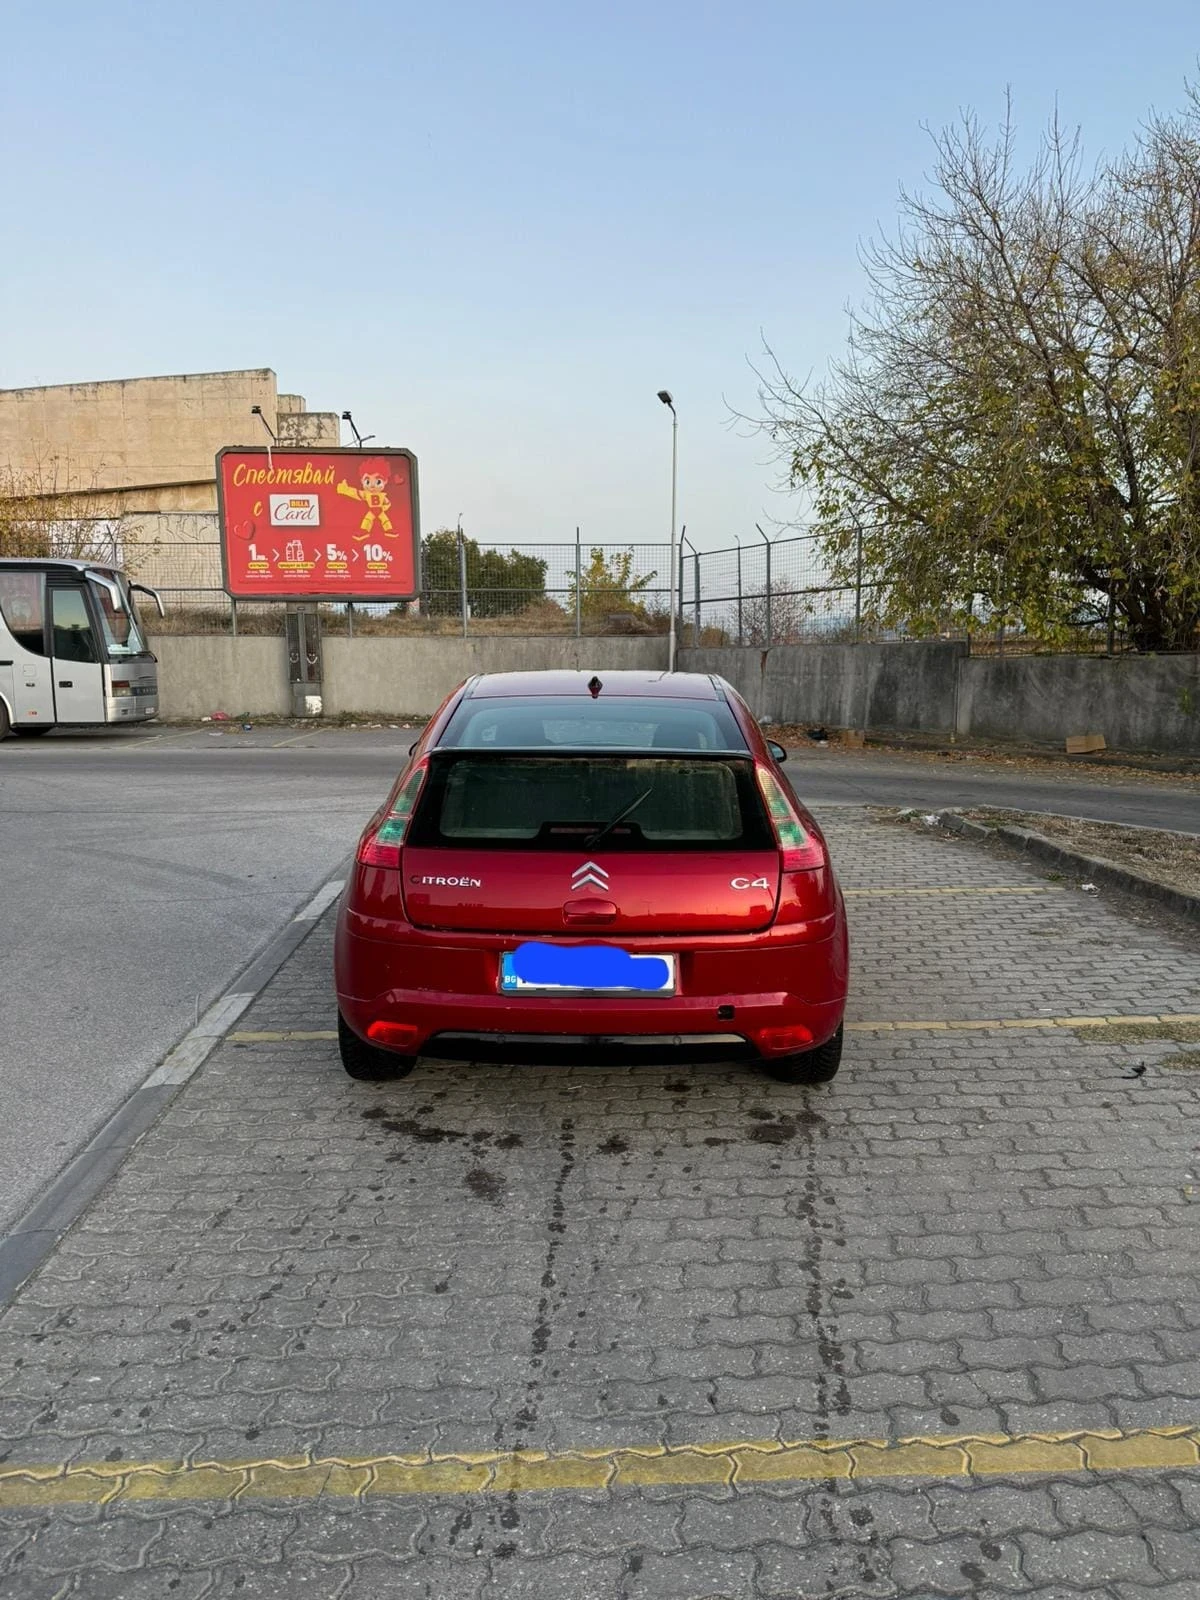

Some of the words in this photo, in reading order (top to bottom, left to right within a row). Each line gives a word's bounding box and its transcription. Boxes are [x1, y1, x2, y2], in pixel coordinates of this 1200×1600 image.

[233, 462, 336, 487] Спестявай
[274, 502, 315, 521] Card
[326, 543, 348, 561] 5%
[363, 543, 393, 562] 10%
[410, 875, 481, 888] CITROËN
[730, 877, 770, 890] C4
[504, 975, 517, 984] BG
